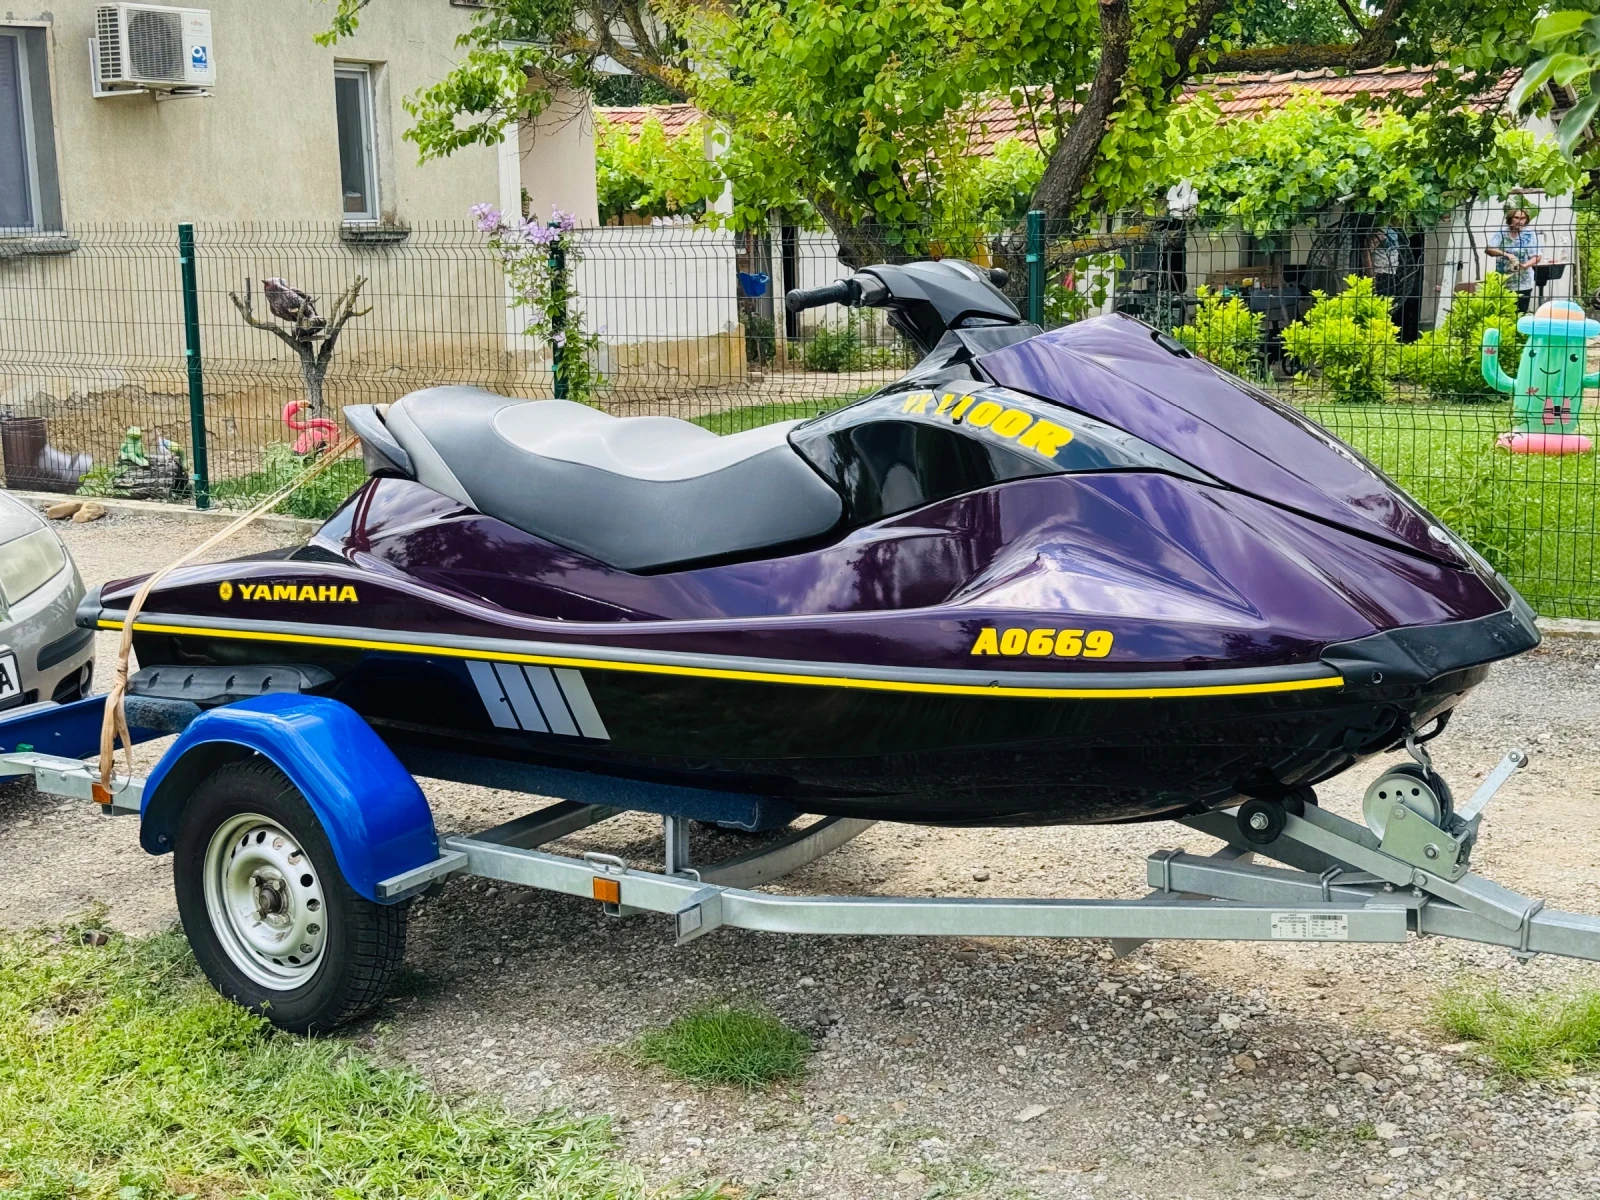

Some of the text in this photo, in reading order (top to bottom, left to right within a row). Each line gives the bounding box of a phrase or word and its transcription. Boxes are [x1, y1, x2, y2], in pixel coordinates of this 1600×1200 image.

[934, 393, 1074, 458] 1100R
[238, 584, 358, 602] YAMAHA
[970, 628, 1114, 658] A0669
